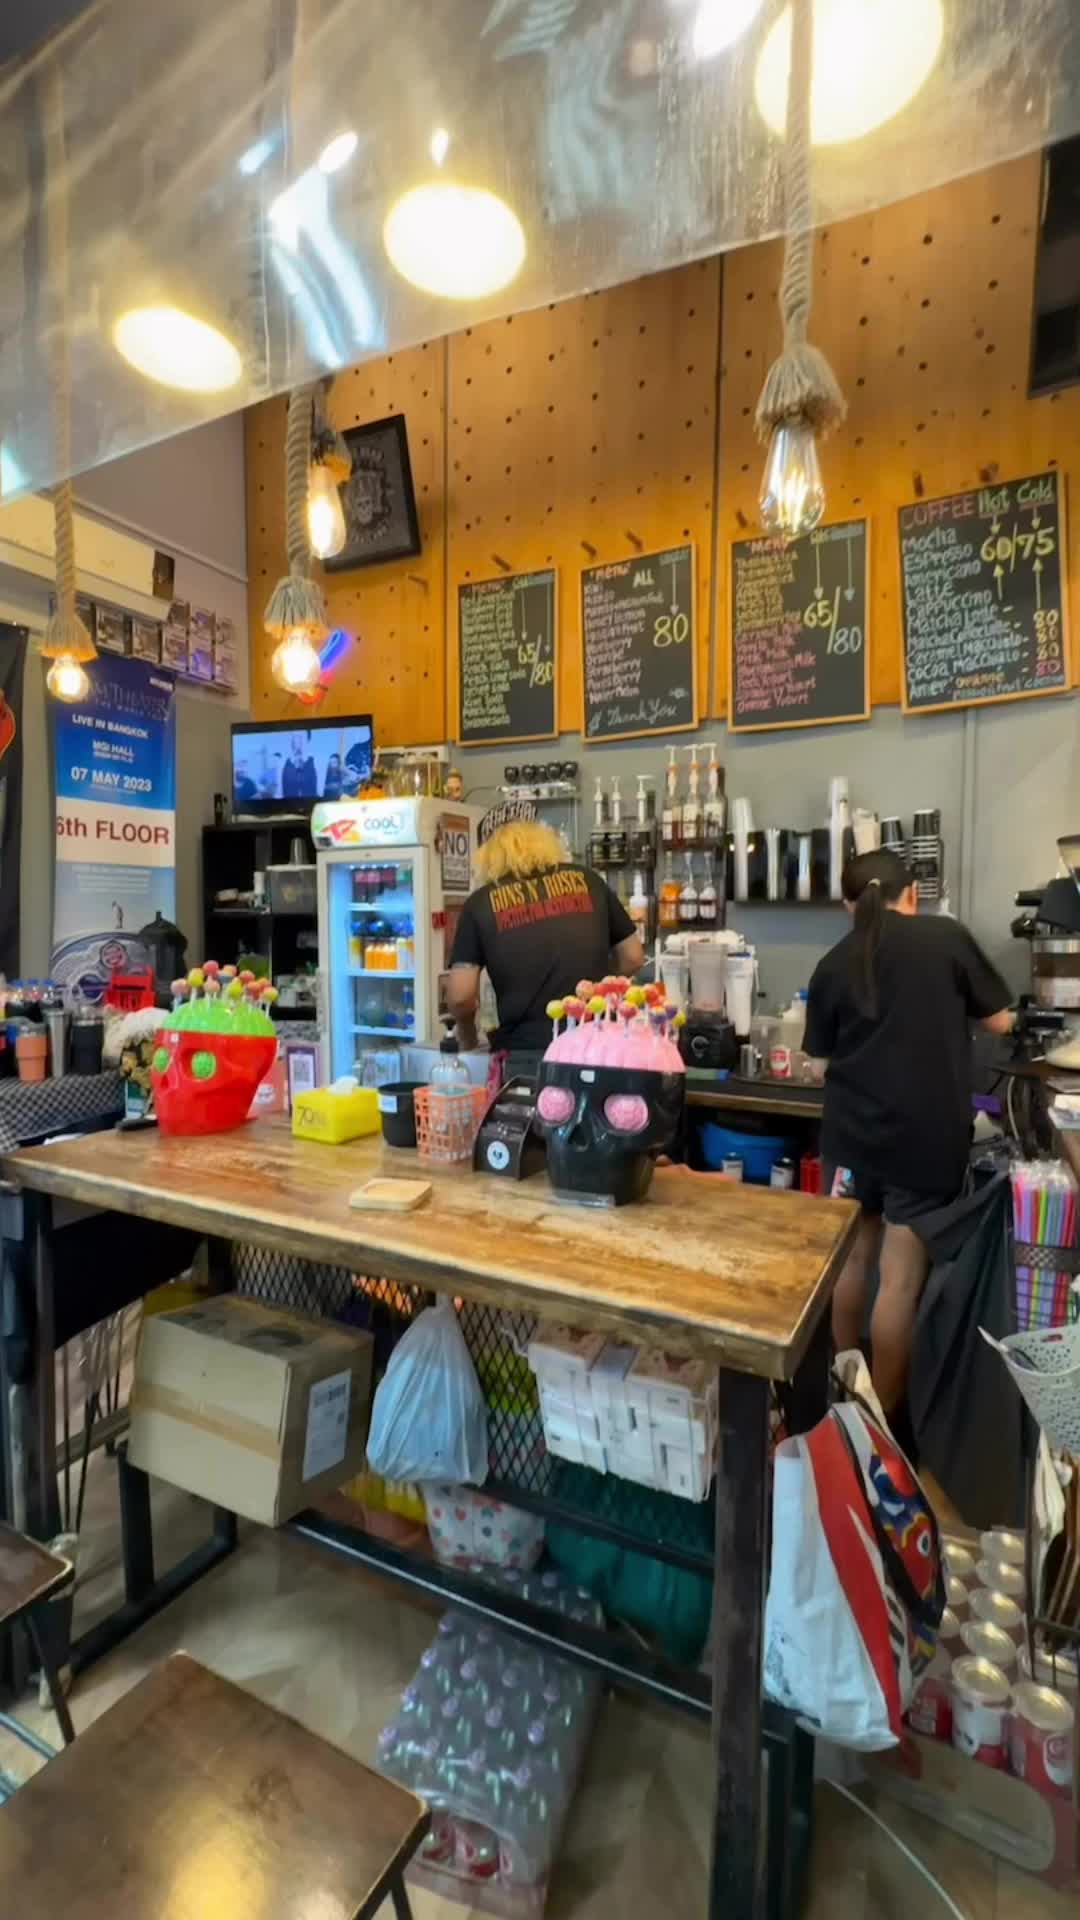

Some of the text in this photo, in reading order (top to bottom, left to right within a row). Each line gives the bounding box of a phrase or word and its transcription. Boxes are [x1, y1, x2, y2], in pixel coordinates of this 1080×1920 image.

[1017, 477, 1056, 505] Cold
[653, 612, 689, 648] 80
[72, 713, 150, 739] LIVE IN BANGKOK
[71, 766, 89, 781] 07
[92, 769, 121, 786] MAY
[123, 776, 153, 793] 2023
[56, 815, 169, 846] 6th FLOOR
[444, 831, 468, 857] NO
[490, 881, 525, 913] GUNS
[542, 869, 590, 901] ROSES
